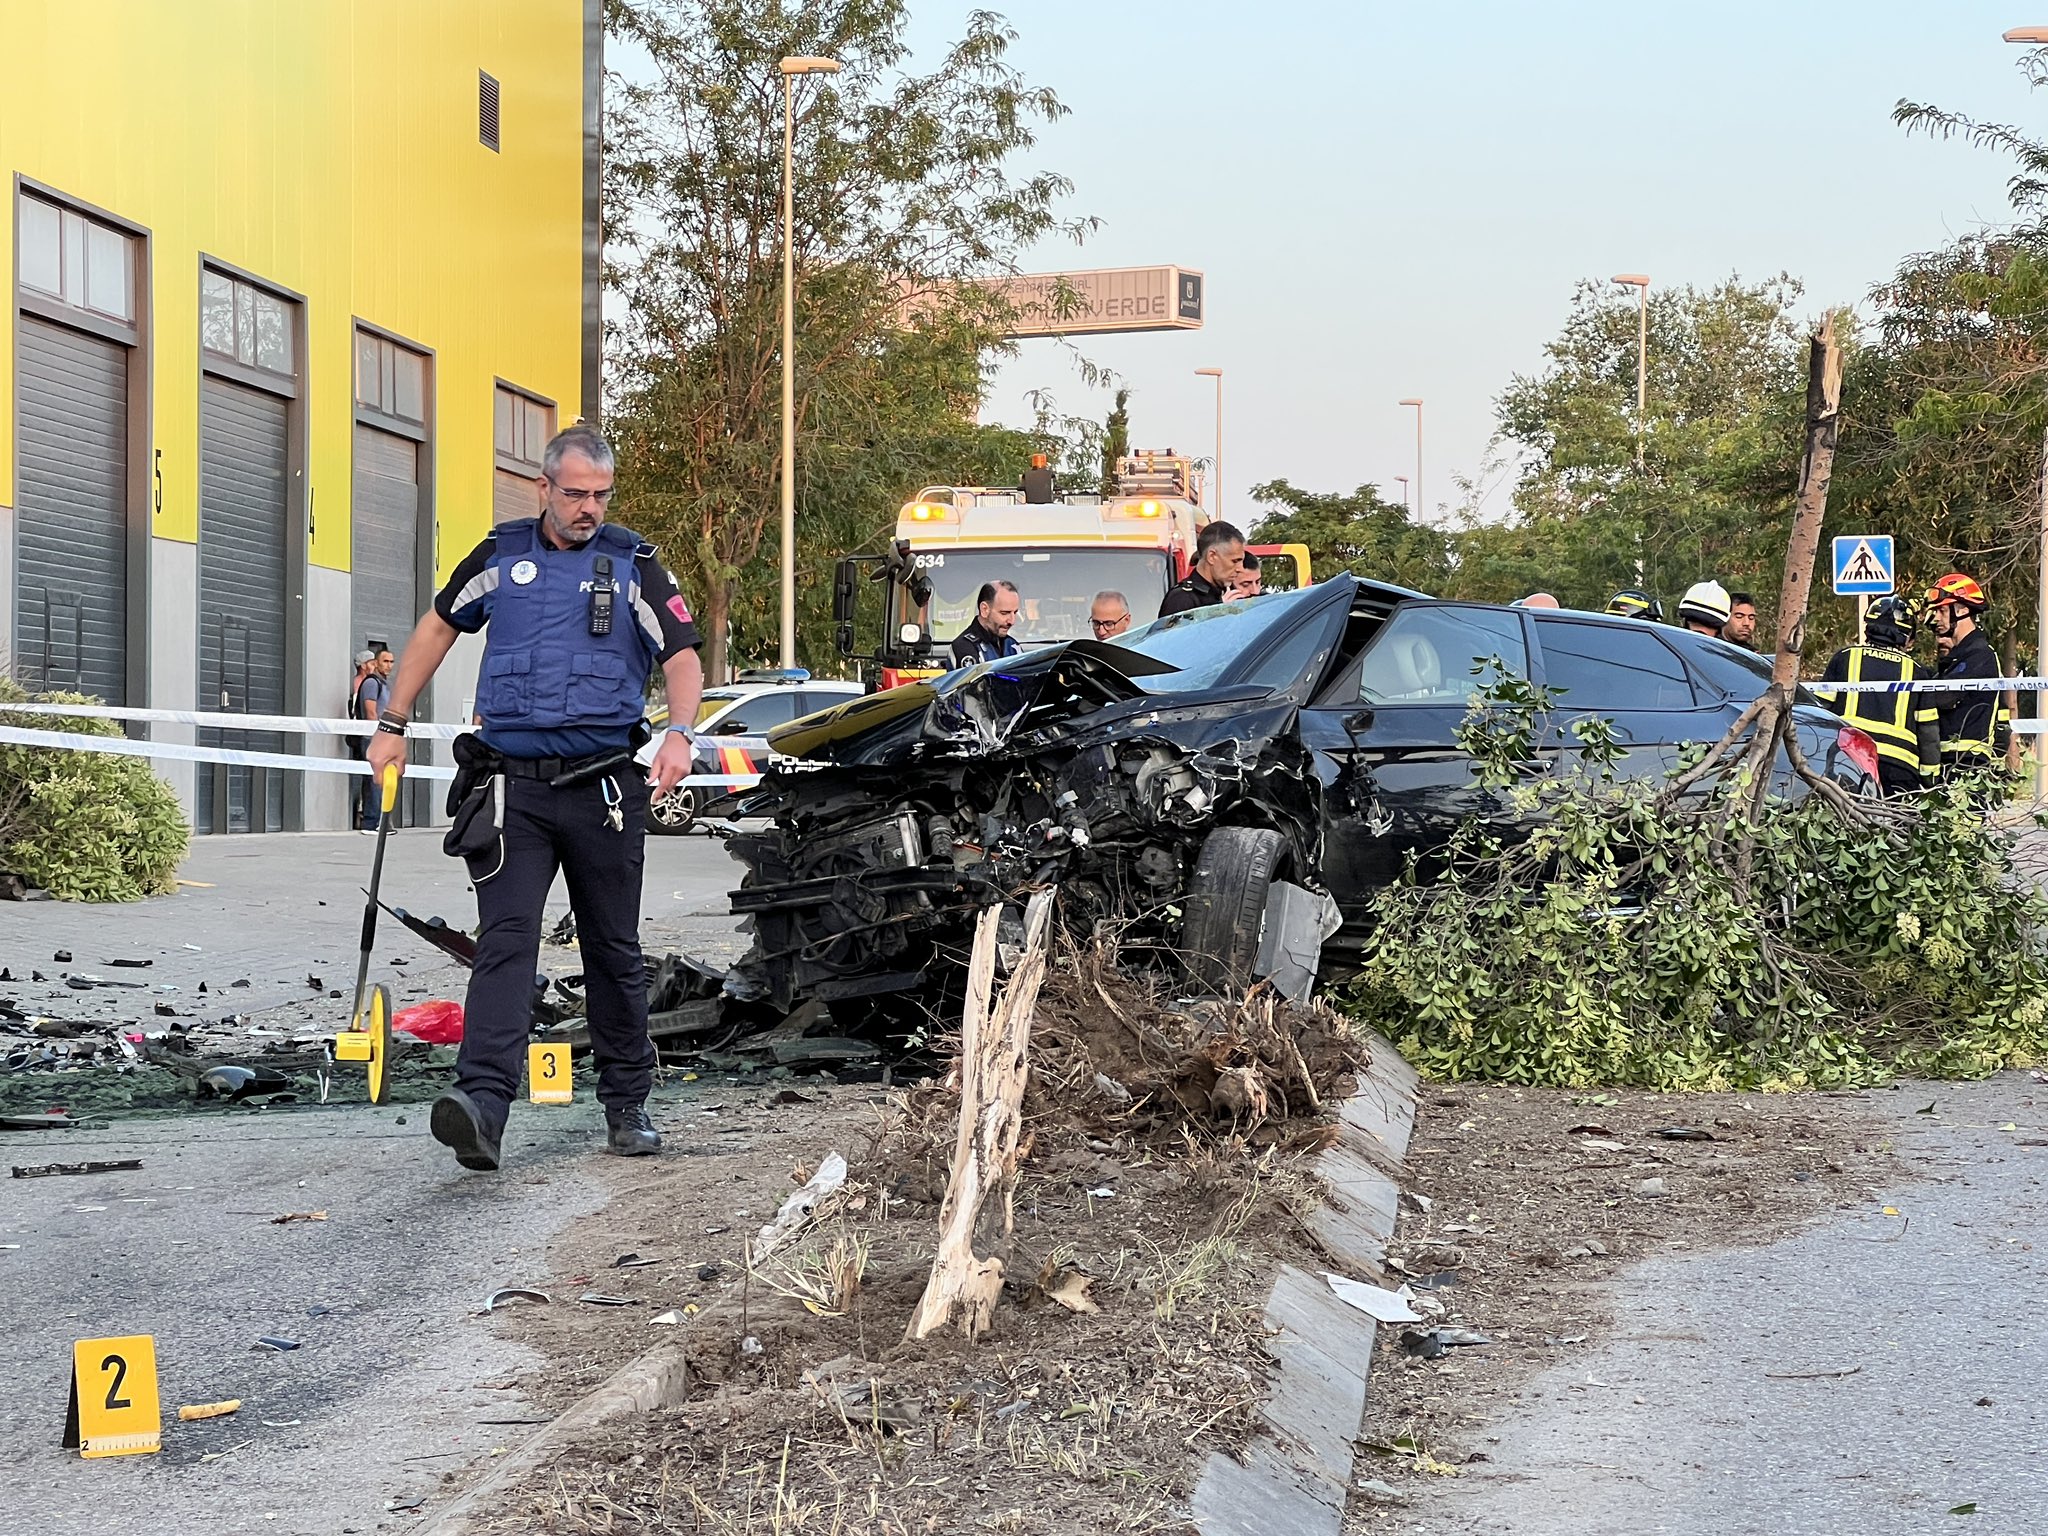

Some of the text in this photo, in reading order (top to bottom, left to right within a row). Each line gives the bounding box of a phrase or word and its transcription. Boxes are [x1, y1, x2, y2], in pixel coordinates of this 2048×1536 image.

[155, 448, 162, 515] 5
[308, 487, 315, 545] 4
[435, 520, 440, 573] 3
[915, 553, 945, 569] 634
[1862, 649, 1902, 663] MADRID
[542, 1052, 556, 1079] 3
[100, 1354, 132, 1410] 2
[80, 1439, 89, 1452] 2
